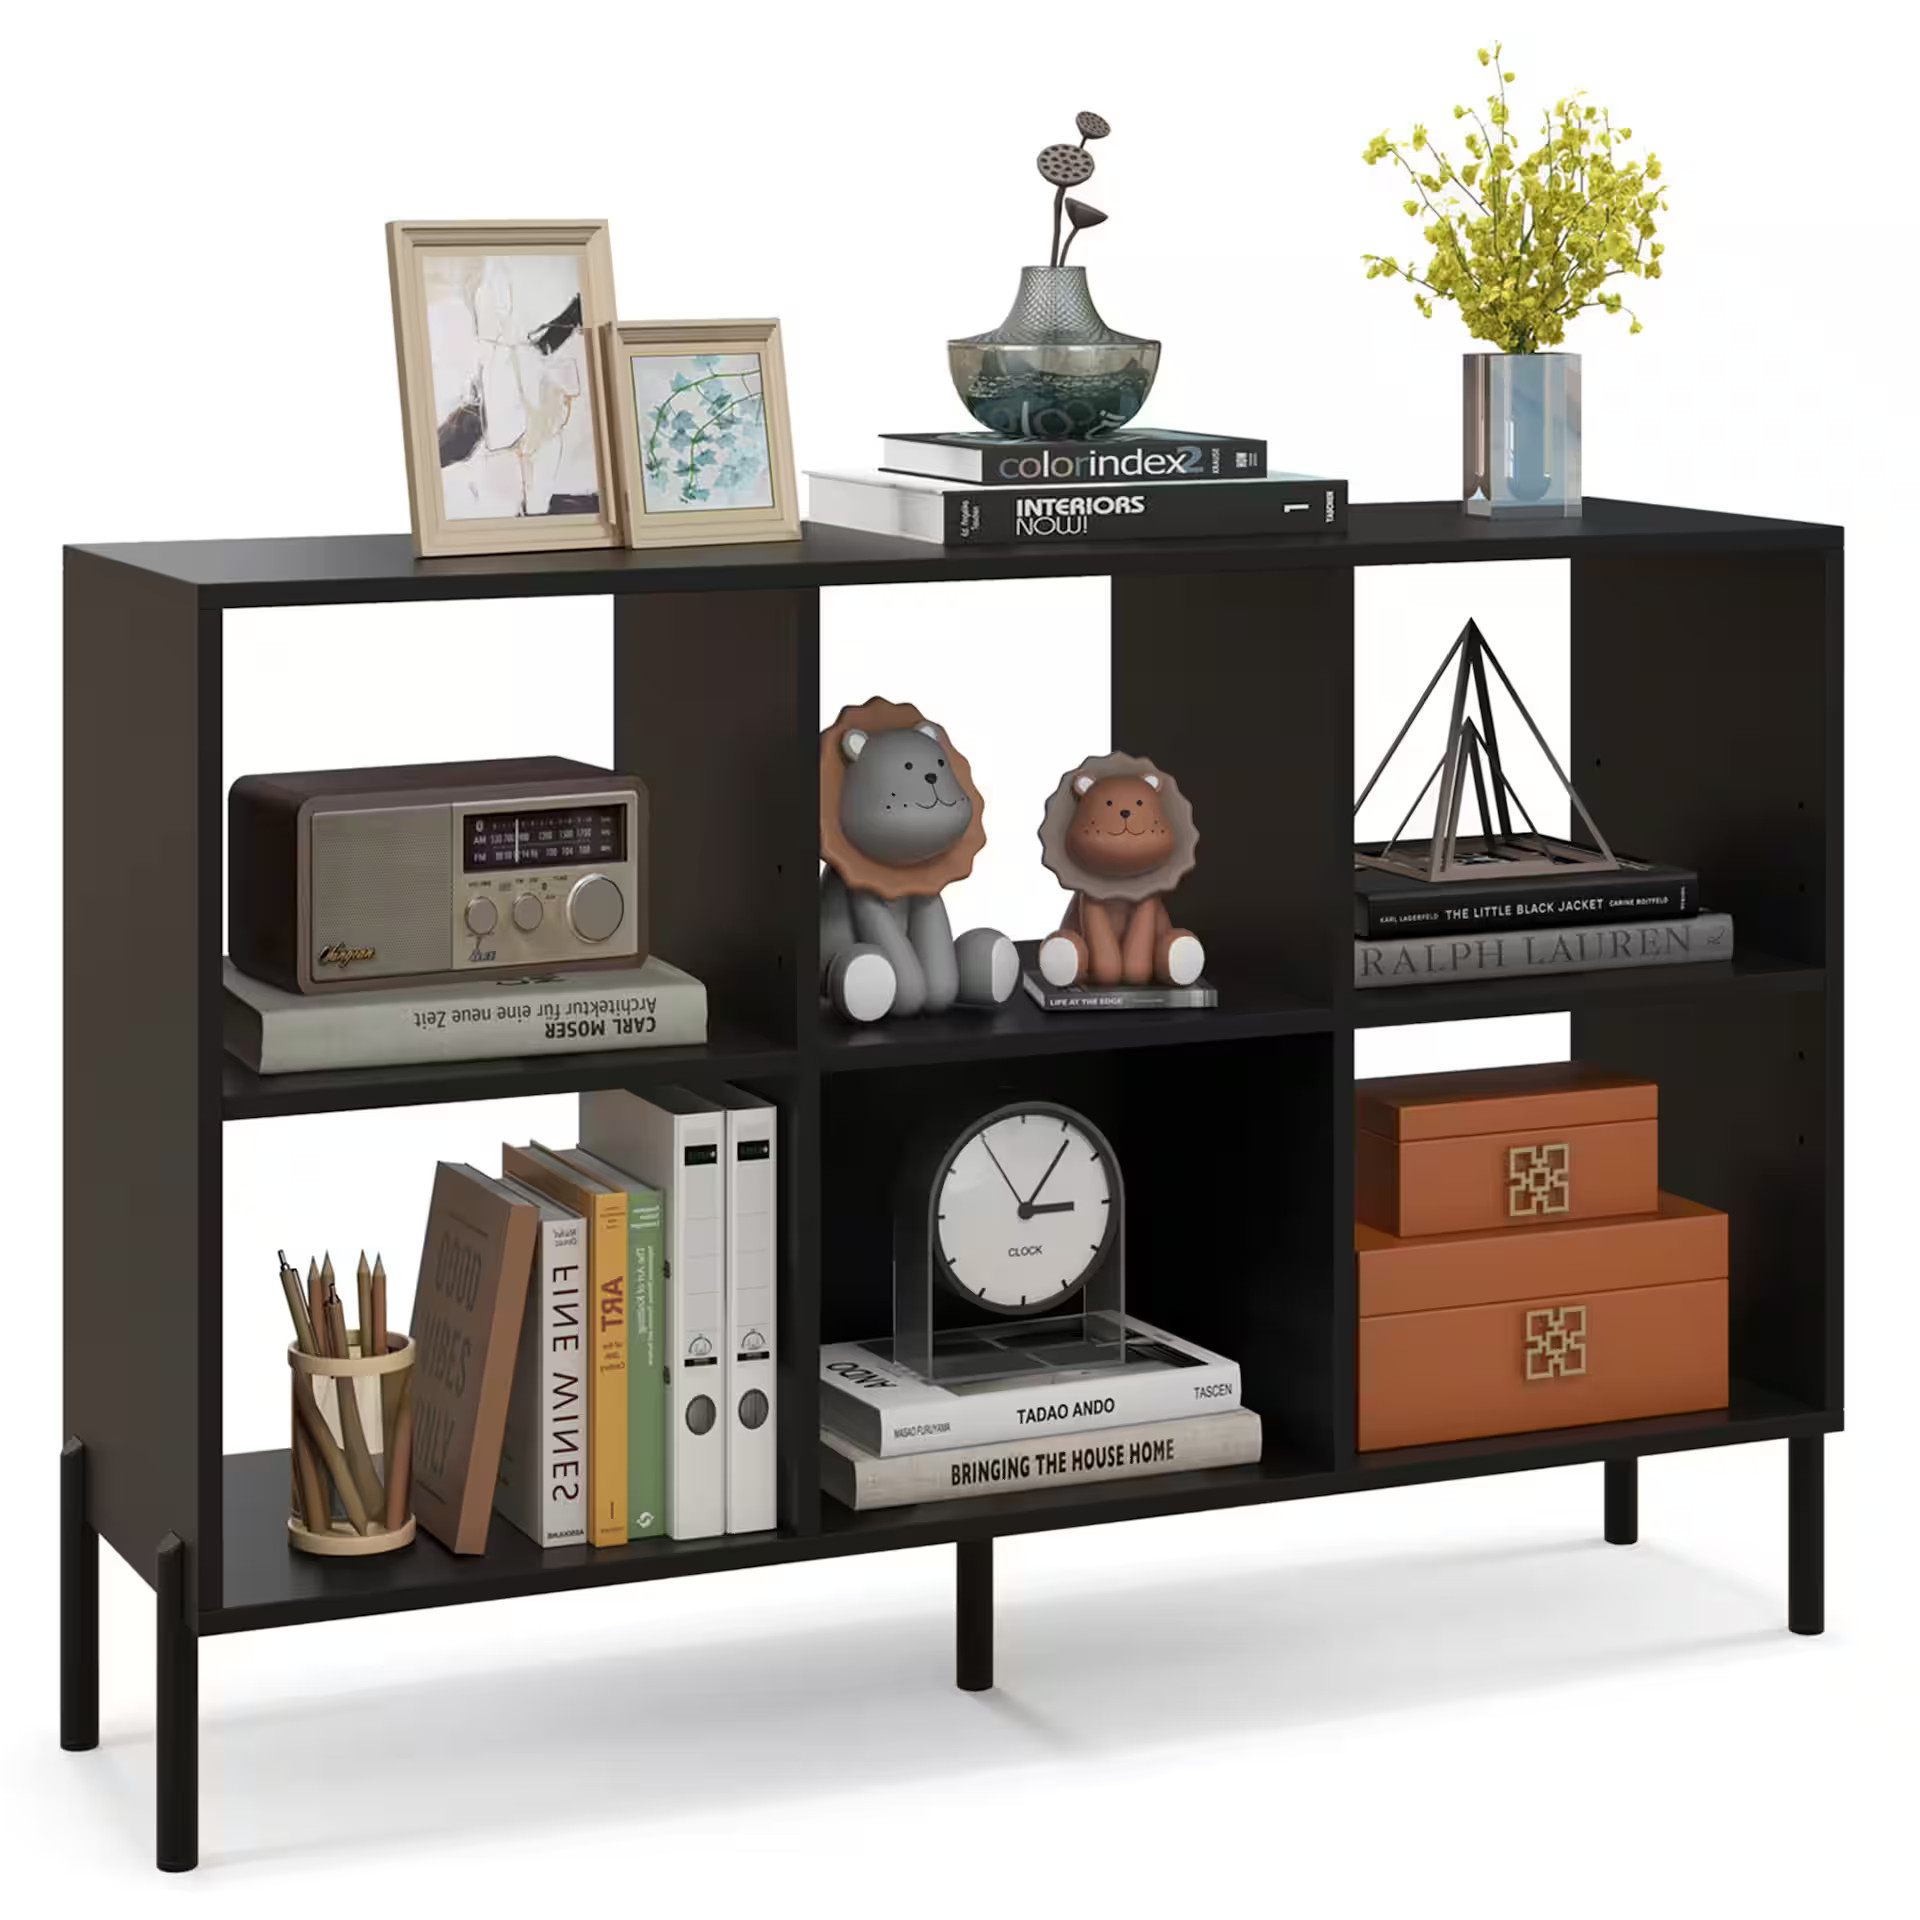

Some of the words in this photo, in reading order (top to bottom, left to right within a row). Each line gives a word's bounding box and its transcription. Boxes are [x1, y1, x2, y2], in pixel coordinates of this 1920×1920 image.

[1016, 496, 1146, 518] INTERIORS
[1016, 516, 1088, 537] NOW!
[473, 835, 486, 845] AM
[474, 853, 486, 862] FM
[1445, 908, 1469, 920] THE
[1473, 905, 1512, 918] LITTLE
[1516, 901, 1554, 916] BLACK
[1558, 898, 1604, 912] JACKET
[1360, 938, 1504, 977] RALPH
[1525, 925, 1693, 966] LAUREN
[565, 997, 657, 1018] Architektur
[1099, 997, 1123, 1005] EDGE
[413, 1011, 447, 1029] Zeit
[452, 1007, 491, 1024] neue
[497, 1005, 531, 1022] eine
[536, 1003, 560, 1020] für
[544, 1020, 605, 1039] MOSER
[612, 1017, 657, 1034] CARL
[1008, 1245, 1043, 1257] CLOCK
[1017, 1402, 1069, 1425] TADAO
[1072, 1398, 1116, 1421] ANDO
[951, 1460, 1031, 1486] BRINGING
[1035, 1452, 1067, 1476] THE
[1071, 1445, 1125, 1471] HOUSE
[1129, 1438, 1175, 1464] HOME
